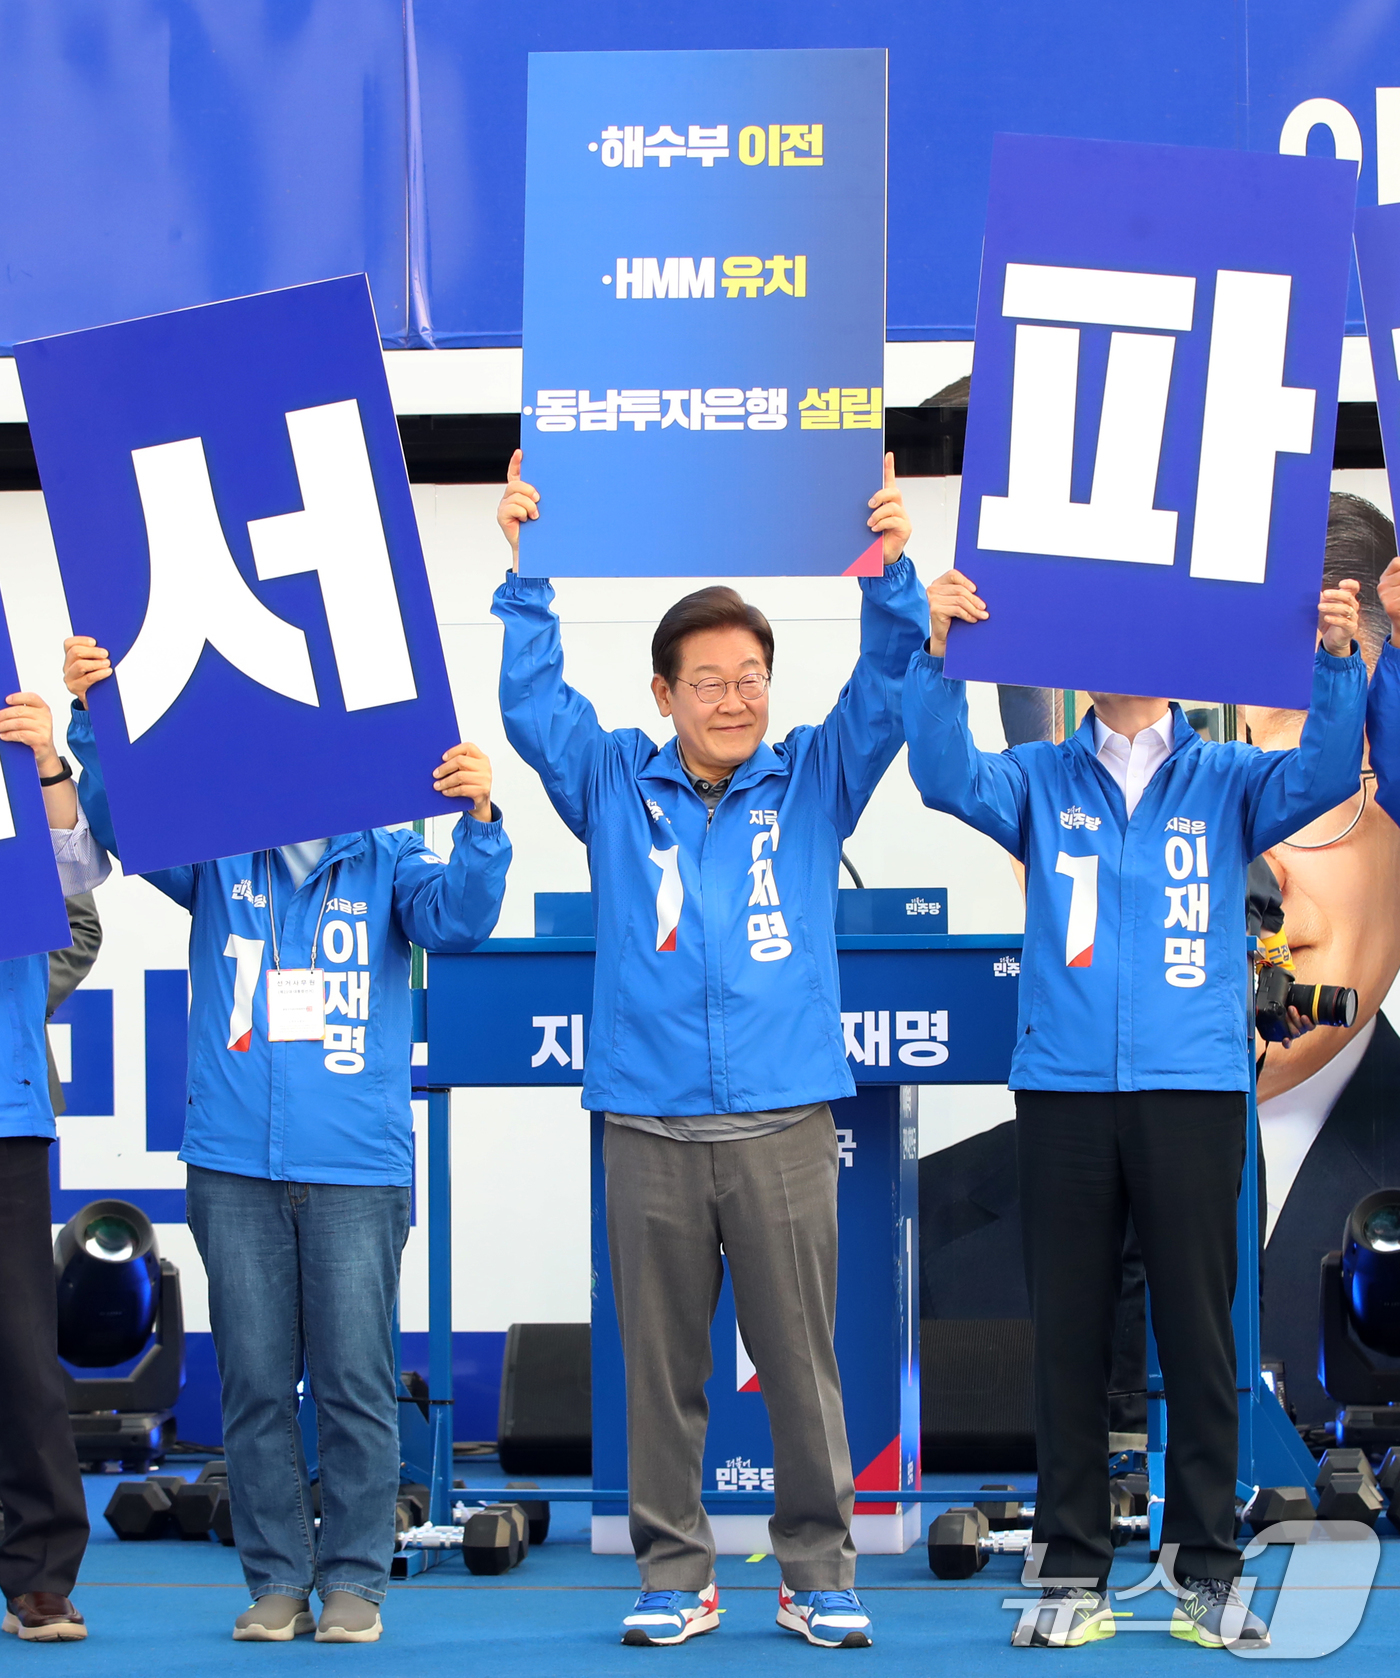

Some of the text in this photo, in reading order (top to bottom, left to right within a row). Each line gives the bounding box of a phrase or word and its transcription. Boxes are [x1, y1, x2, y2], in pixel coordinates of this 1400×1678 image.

[738, 124, 823, 166] 이전
[721, 255, 806, 298] 유치
[798, 387, 882, 430] 설립
[978, 263, 1316, 584] 파
[115, 398, 418, 744] 서
[749, 809, 778, 825] 지금
[1060, 810, 1102, 831] 민주당
[1164, 817, 1207, 835] 지금은
[325, 897, 369, 916] 지금은
[905, 902, 942, 915] 민주당
[1055, 851, 1099, 968] 1
[1164, 835, 1209, 988] 이재명
[993, 962, 1020, 977] 민주
[223, 933, 265, 1053] 1
[322, 919, 371, 1075] 이재명
[531, 1010, 949, 1071] 지 재명
